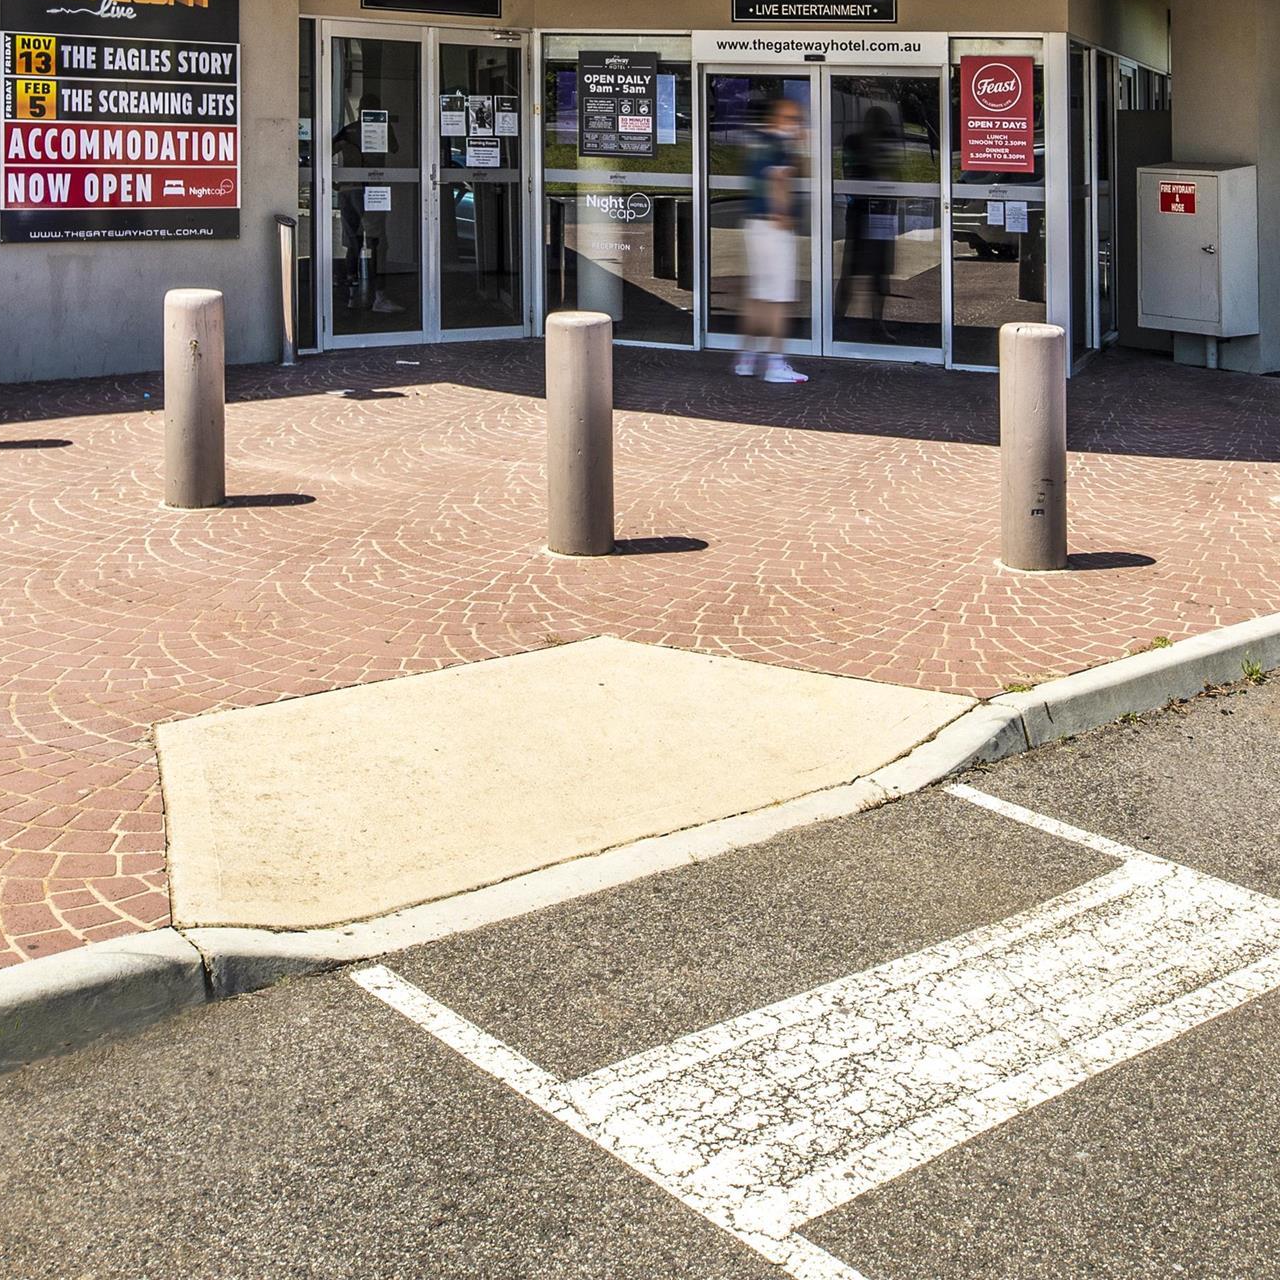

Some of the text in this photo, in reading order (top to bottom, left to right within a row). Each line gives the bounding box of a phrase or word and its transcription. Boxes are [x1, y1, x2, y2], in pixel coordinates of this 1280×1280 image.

[756, 4, 872, 16] LIVE ENTERTAINMENT
[21, 38, 52, 50] NOV
[716, 38, 921, 54] www.thegatewayhotel.com.au
[19, 51, 52, 74] 13
[61, 45, 233, 75] THE EAGLES STORY
[584, 74, 651, 85] OPEN DAILY
[977, 78, 1016, 96] Feast
[24, 82, 51, 94] FEB
[589, 84, 612, 93] 9am
[622, 85, 646, 94] 5am
[28, 96, 46, 118] 5
[62, 89, 235, 116] THE SCREAMING JETS
[968, 121, 1027, 129] OPEN 7 DAYS
[8, 127, 234, 161] ACCOMMODATION
[8, 173, 152, 203] NOW OPEN
[1161, 184, 1195, 194] FIRE HYDRANT
[586, 194, 625, 213] Night
[1171, 203, 1185, 212] HOSE
[608, 208, 636, 223] cap
[29, 228, 214, 239] WWW.THEGATEWAYHOTEL.COM.AU
